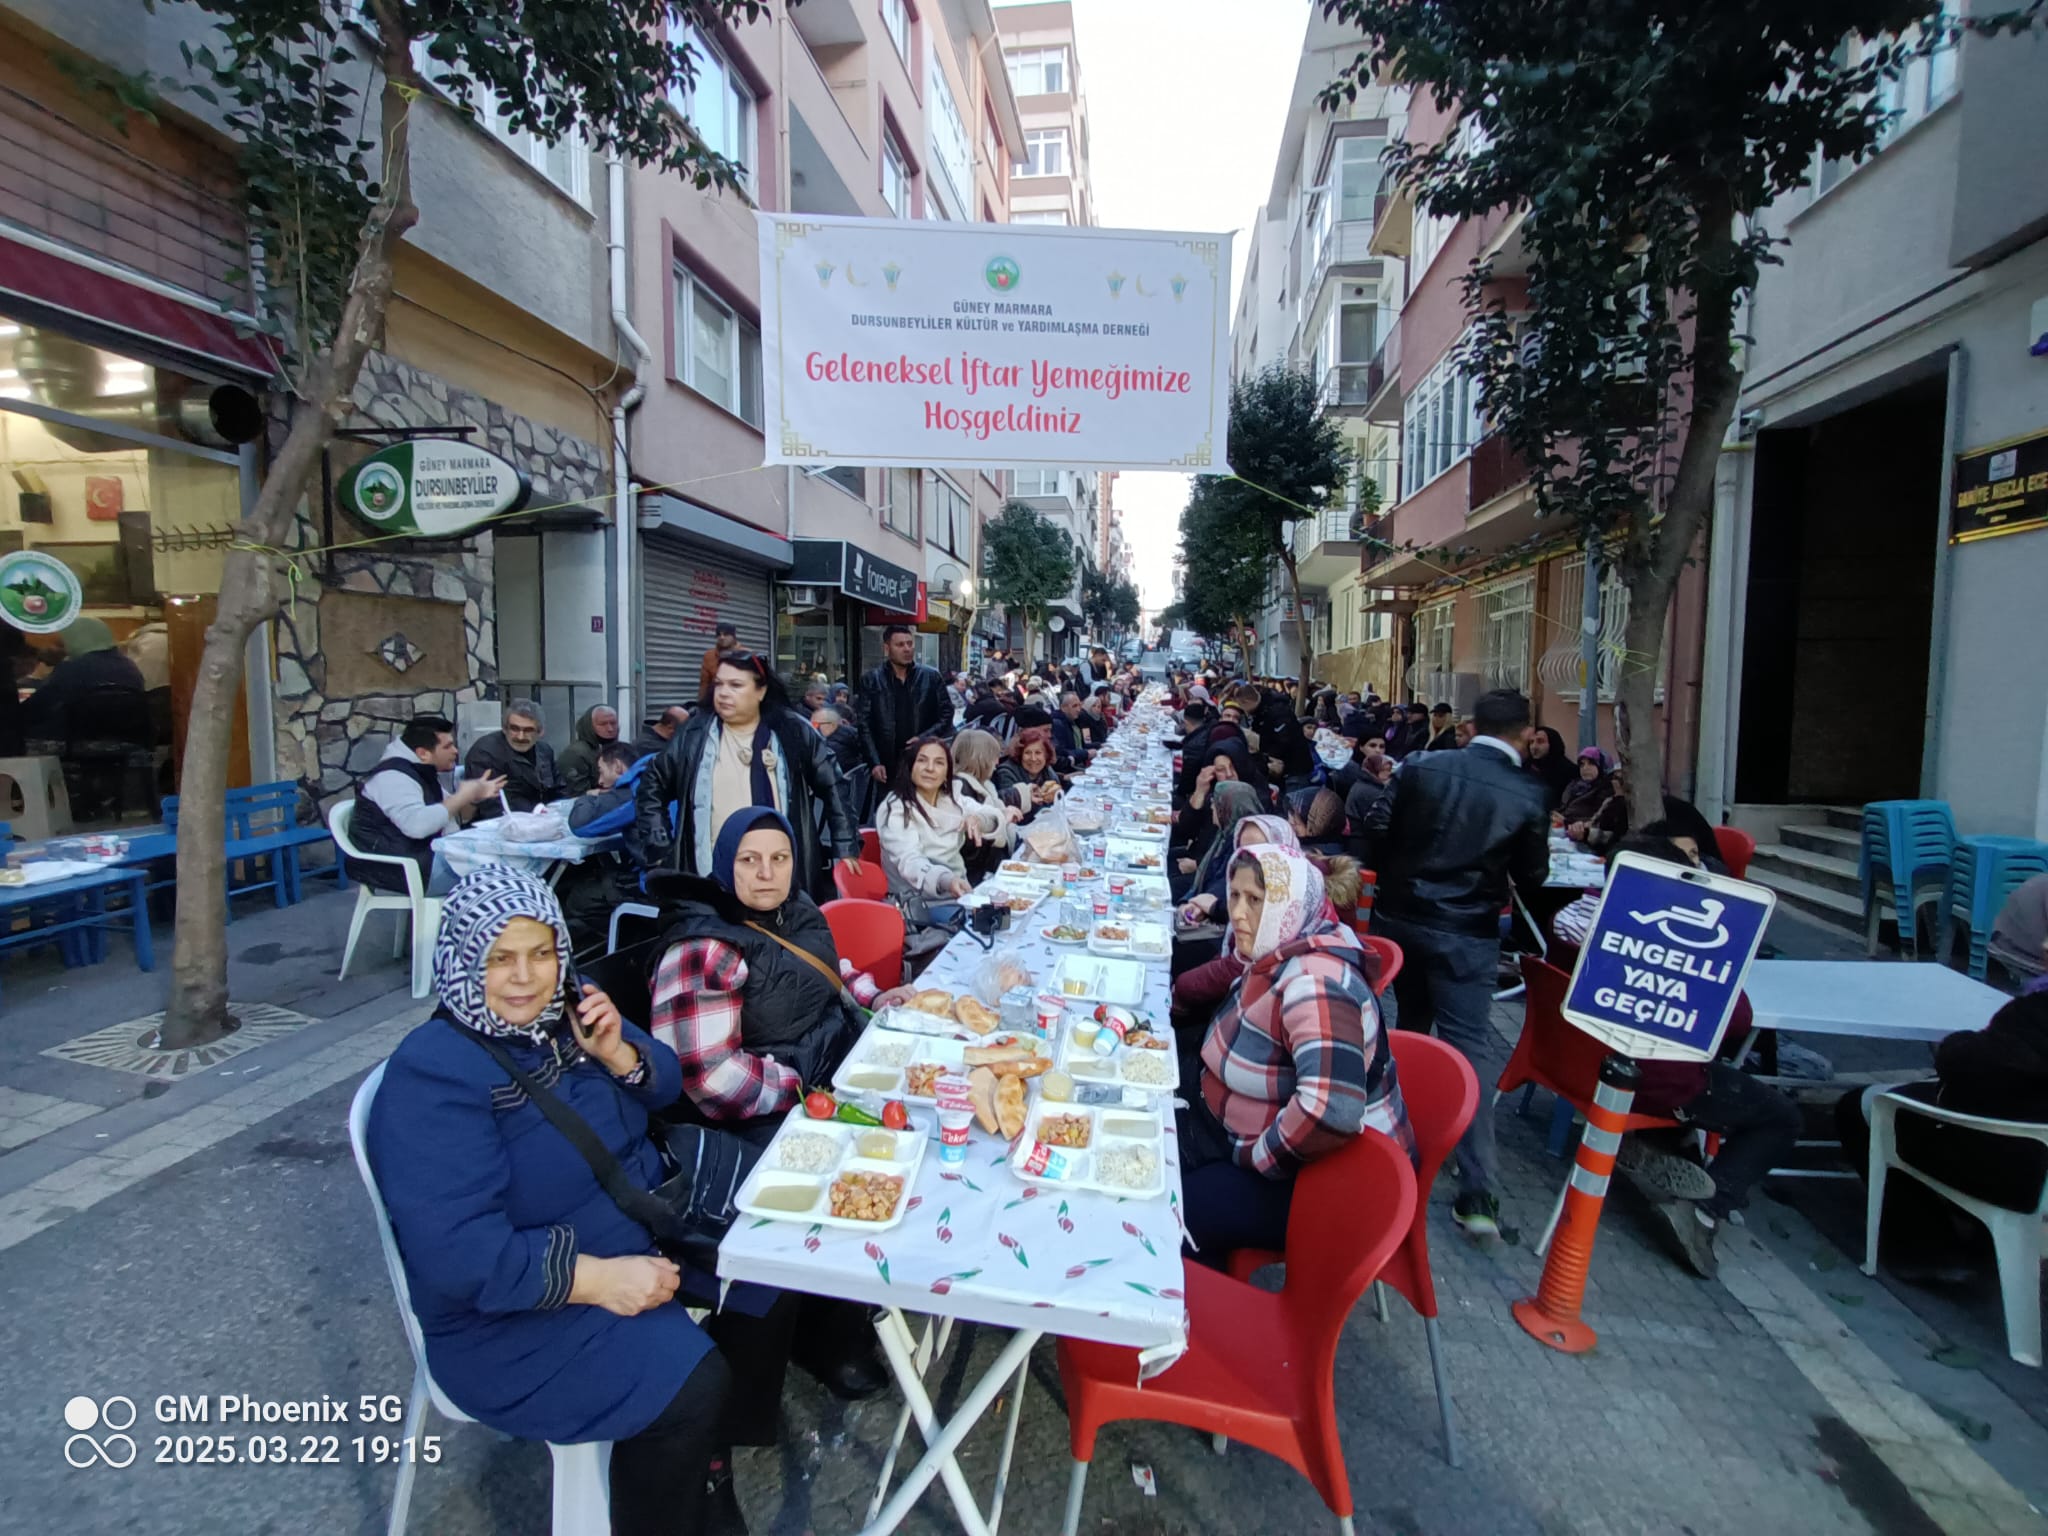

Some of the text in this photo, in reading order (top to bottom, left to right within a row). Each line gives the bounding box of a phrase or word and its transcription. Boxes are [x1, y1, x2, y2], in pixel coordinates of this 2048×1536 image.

[851, 313, 1150, 336] DURSUNBEYLİLER KÜLTÜR ve YARDIMLAŞMA DERNEĞİ
[953, 299, 1053, 316] GÜNEY MARMARA
[806, 351, 1192, 400] Geleneksel İftar Yemeğimize
[925, 400, 1081, 440] Hoşgeldiniz
[420, 457, 491, 472] GÜNEY MARMARA
[416, 472, 498, 497] DURSUNBEYLİLER
[867, 564, 898, 598] forever
[1601, 931, 1732, 984] ENGELLİ
[1624, 965, 1687, 1002] YAYA
[1594, 987, 1698, 1032] GEÇİDİ
